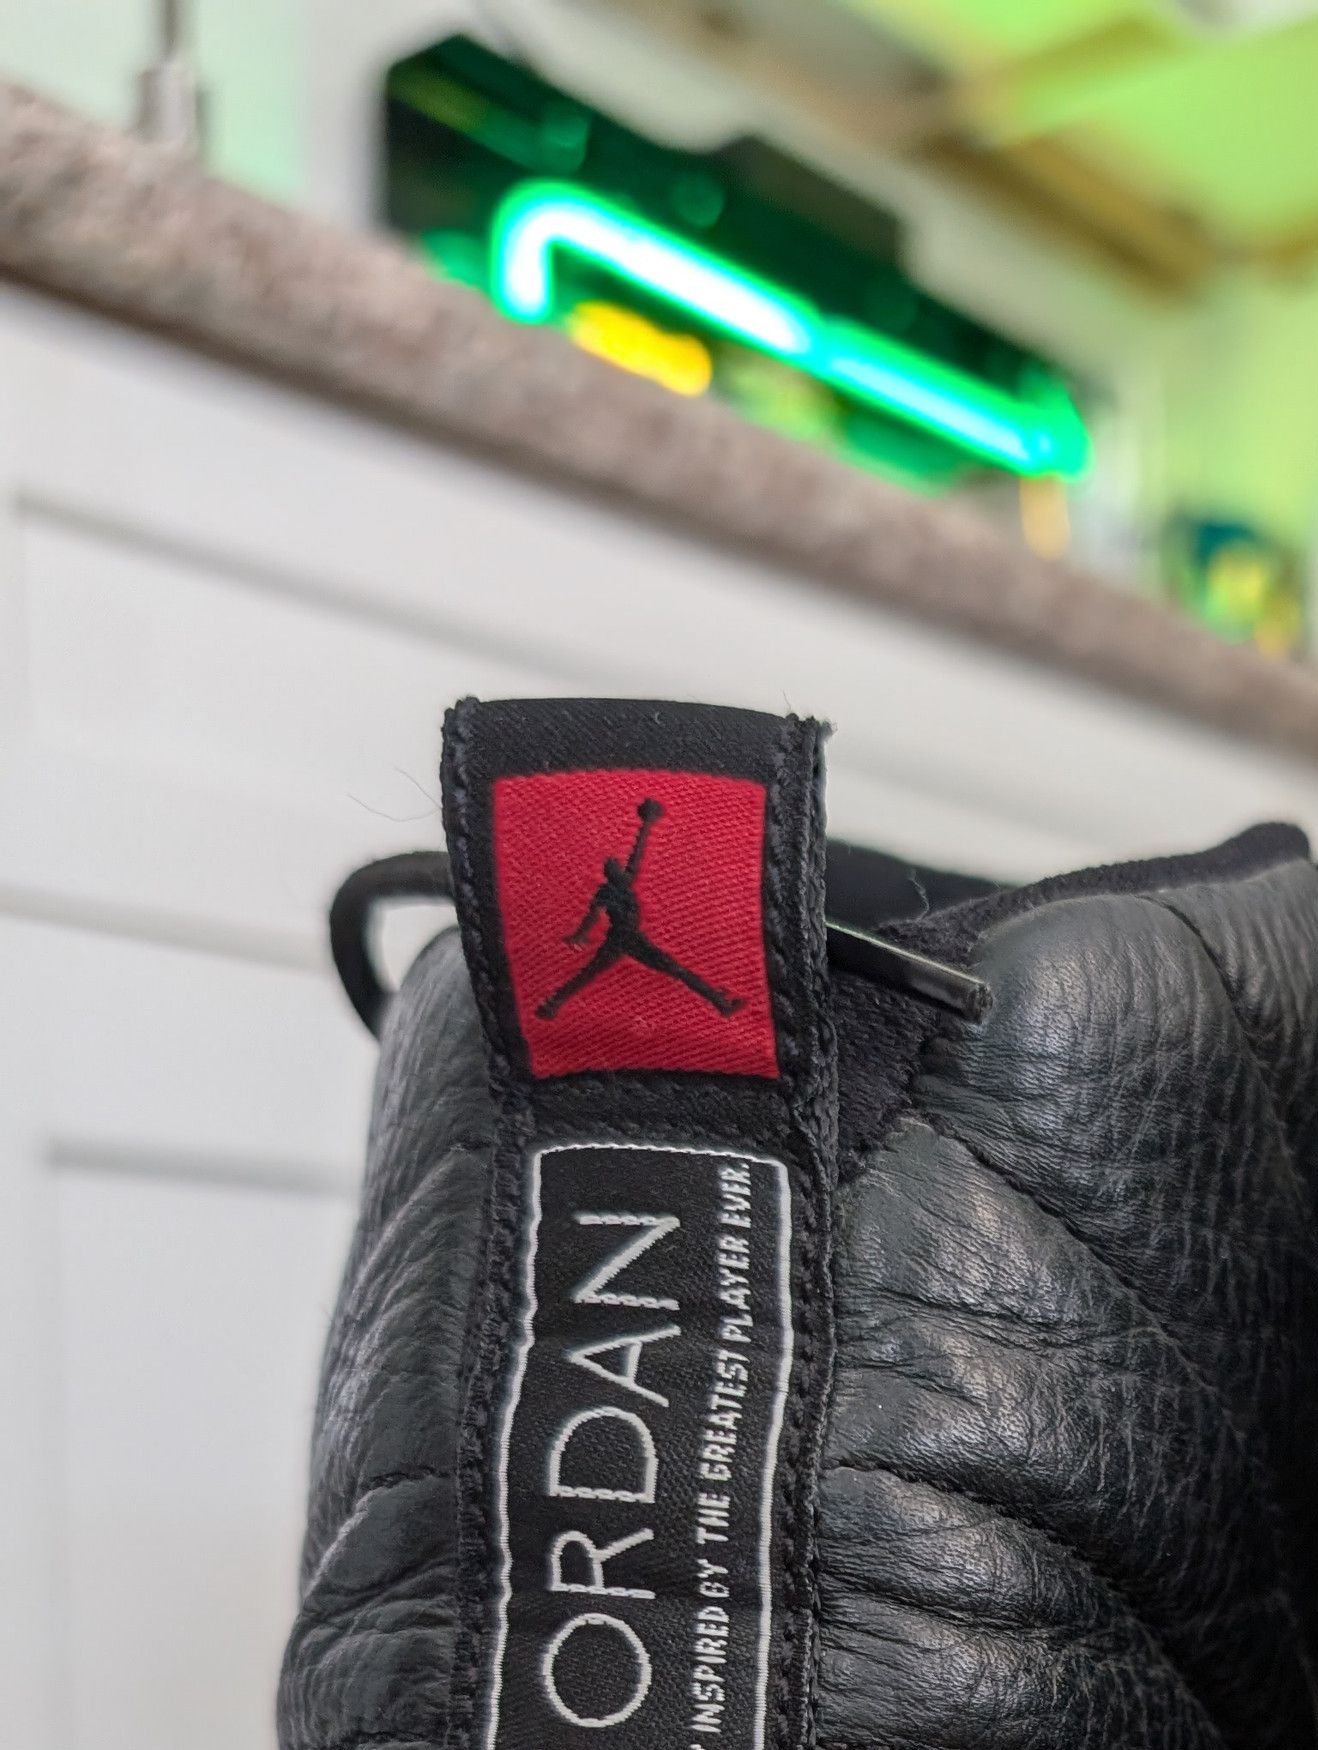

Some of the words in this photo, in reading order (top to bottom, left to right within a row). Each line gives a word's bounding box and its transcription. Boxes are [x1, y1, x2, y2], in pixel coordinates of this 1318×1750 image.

[718, 1162, 752, 1228] EVER.
[718, 1235, 753, 1342] PLAYER
[700, 1350, 750, 1481] GREATEST
[696, 1491, 730, 1544] THE
[696, 1558, 730, 1599] BY
[691, 1605, 730, 1733] INSPIRED
